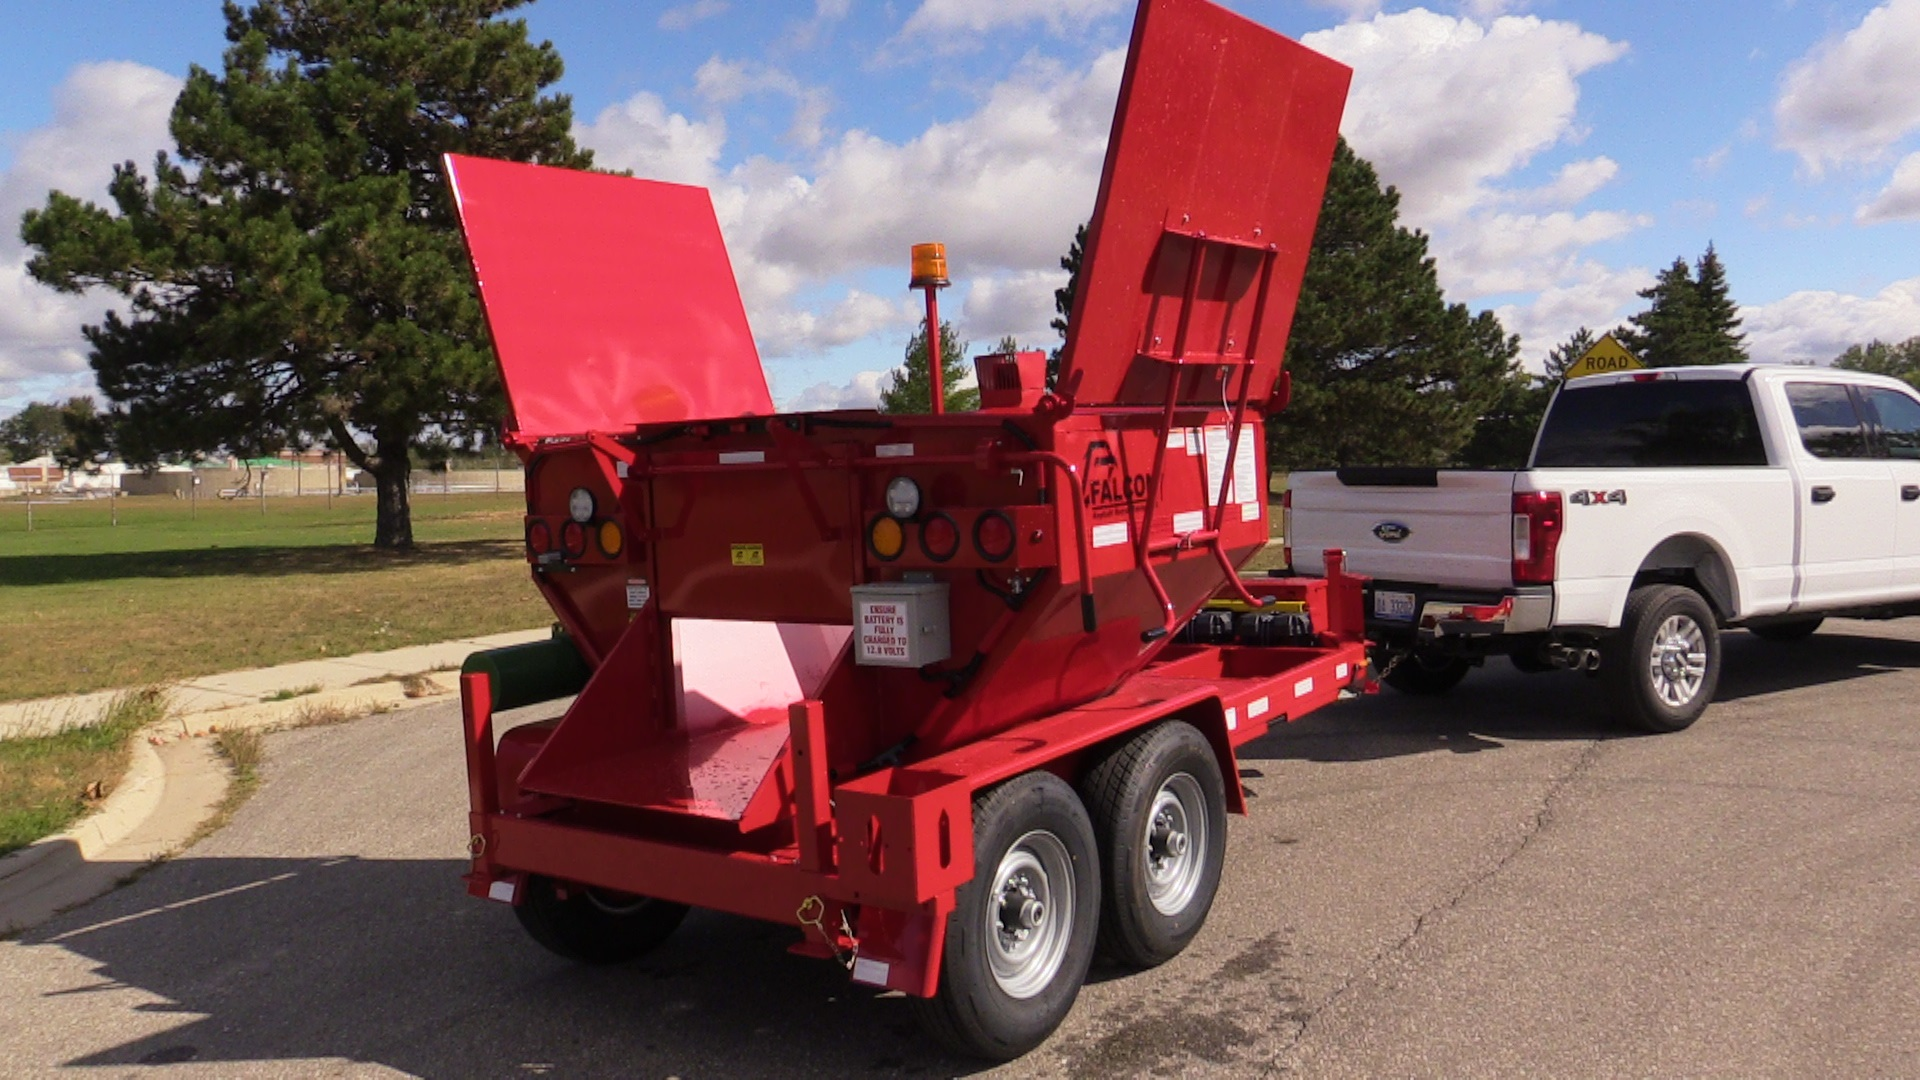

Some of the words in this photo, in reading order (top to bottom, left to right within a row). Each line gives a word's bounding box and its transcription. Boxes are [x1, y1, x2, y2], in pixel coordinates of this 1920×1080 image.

[1586, 355, 1628, 370] ROAD
[870, 605, 896, 614] ENSURE
[864, 615, 895, 624] BATTERY
[897, 616, 904, 625] IS
[874, 625, 894, 634] FULLY
[863, 635, 896, 645] CHARGED
[898, 637, 907, 646] TO
[884, 647, 905, 656] VOLTS
